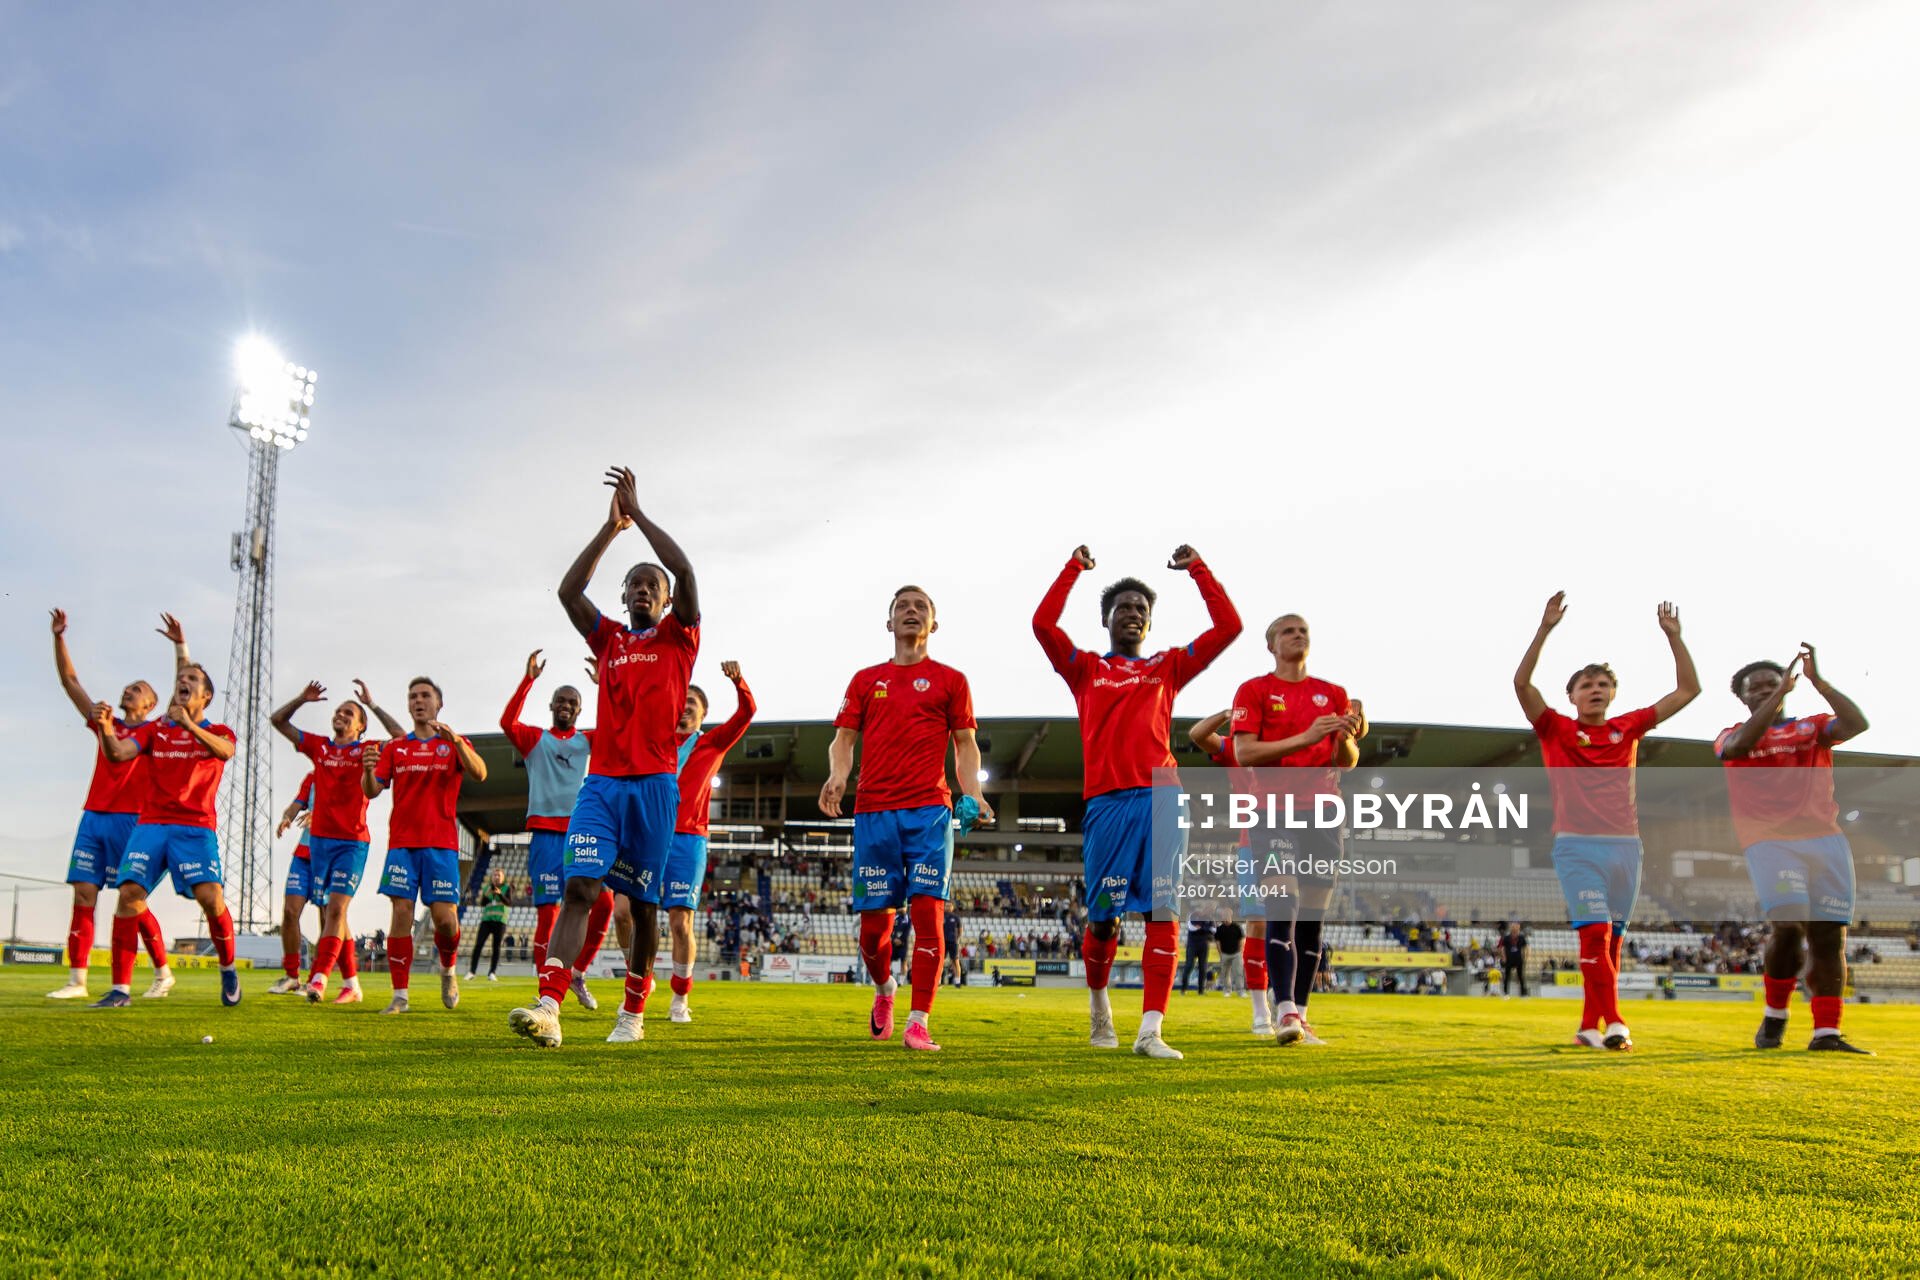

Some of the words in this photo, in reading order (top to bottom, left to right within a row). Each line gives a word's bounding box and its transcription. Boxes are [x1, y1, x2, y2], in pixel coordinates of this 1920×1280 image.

[569, 834, 597, 845] Fibio
[574, 847, 598, 857] Solid
[388, 864, 408, 875] Fibio
[859, 866, 887, 877] Fibio
[914, 863, 939, 876] Fibio
[432, 880, 453, 888] Fibio
[867, 880, 888, 890] Solid
[1102, 876, 1128, 888] Fibio
